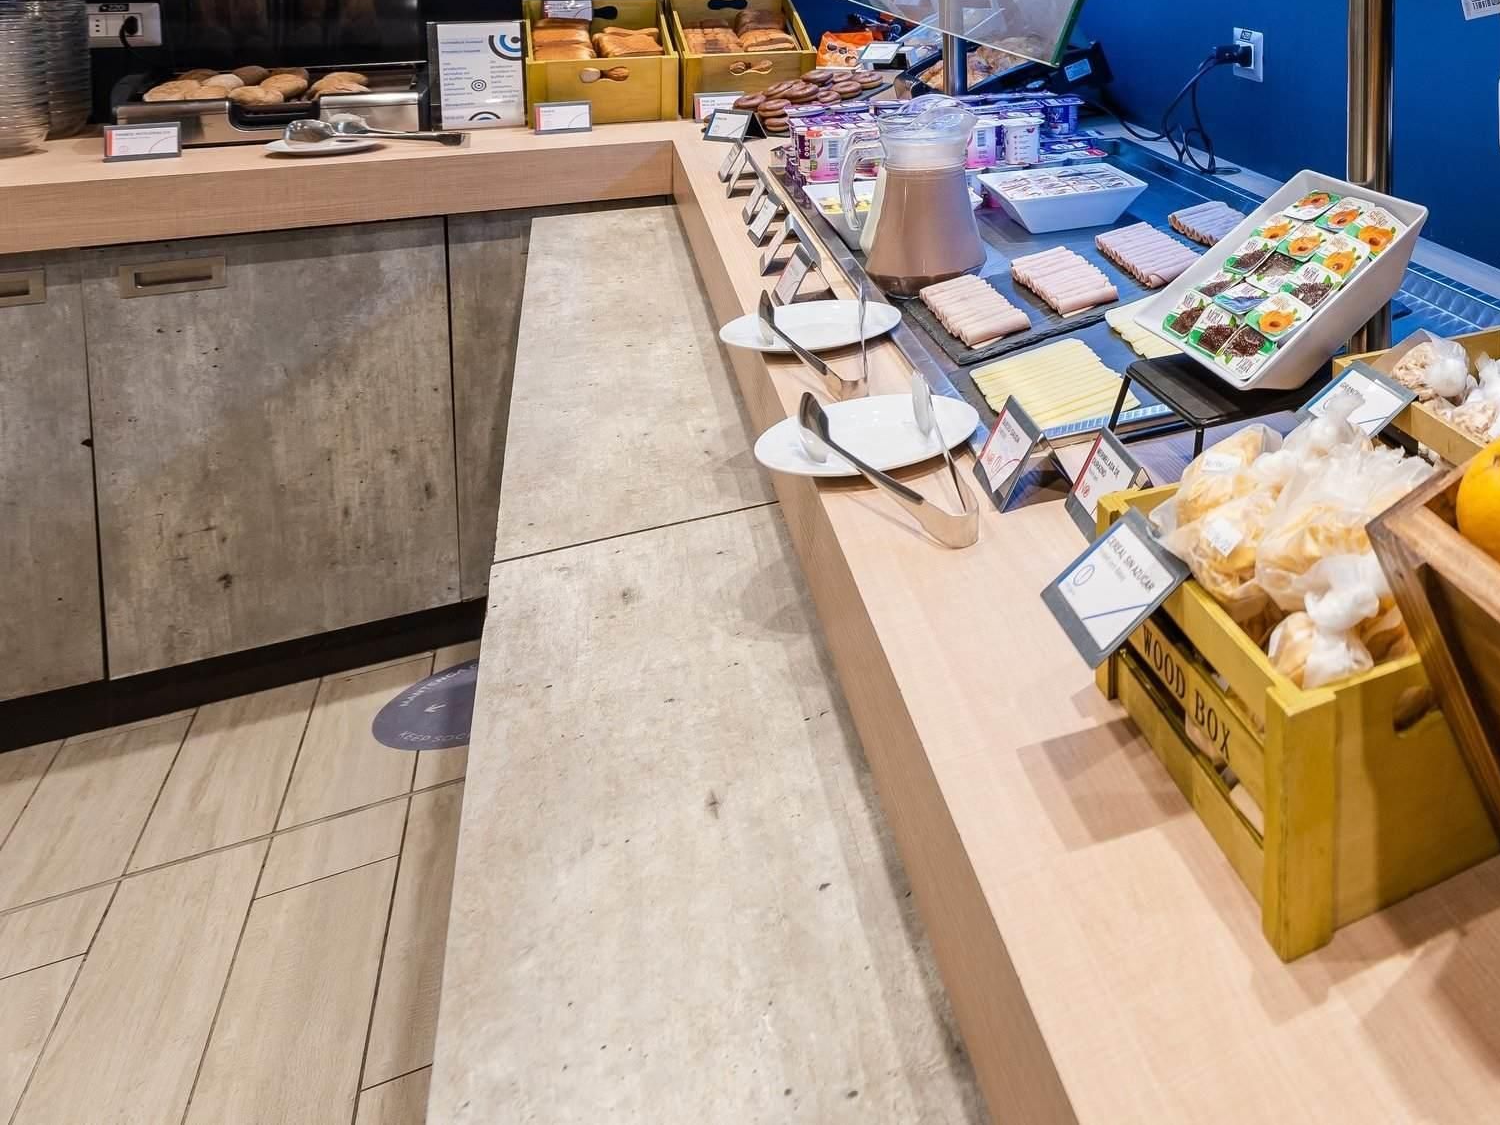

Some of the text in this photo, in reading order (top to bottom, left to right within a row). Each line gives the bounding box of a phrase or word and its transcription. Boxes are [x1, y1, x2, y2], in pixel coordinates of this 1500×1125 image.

[1143, 624, 1230, 761] WOOD BOX
[399, 730, 431, 742] KEEP
